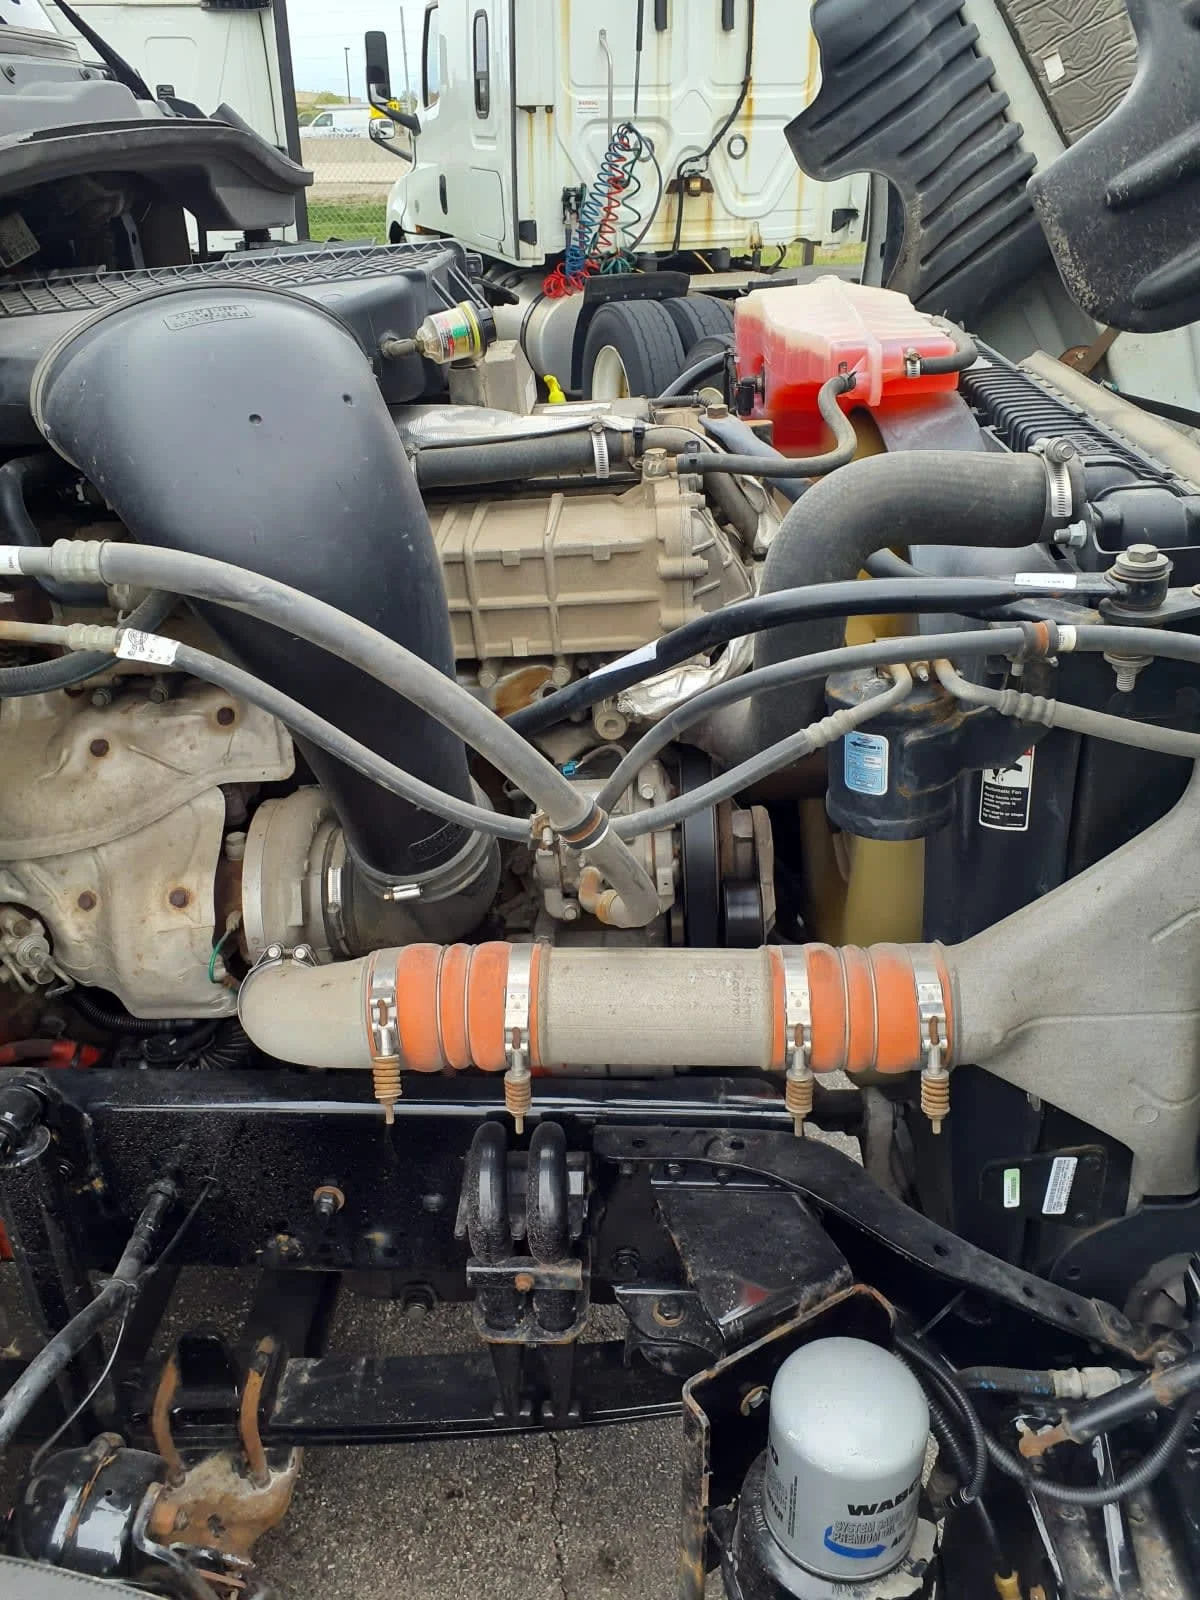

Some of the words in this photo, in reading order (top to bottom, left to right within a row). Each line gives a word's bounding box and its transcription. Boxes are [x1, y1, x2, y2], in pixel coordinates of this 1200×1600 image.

[847, 1477, 920, 1516] WABC
[833, 1520, 876, 1535] SYSTEM
[832, 1531, 881, 1545] PREMIUM
